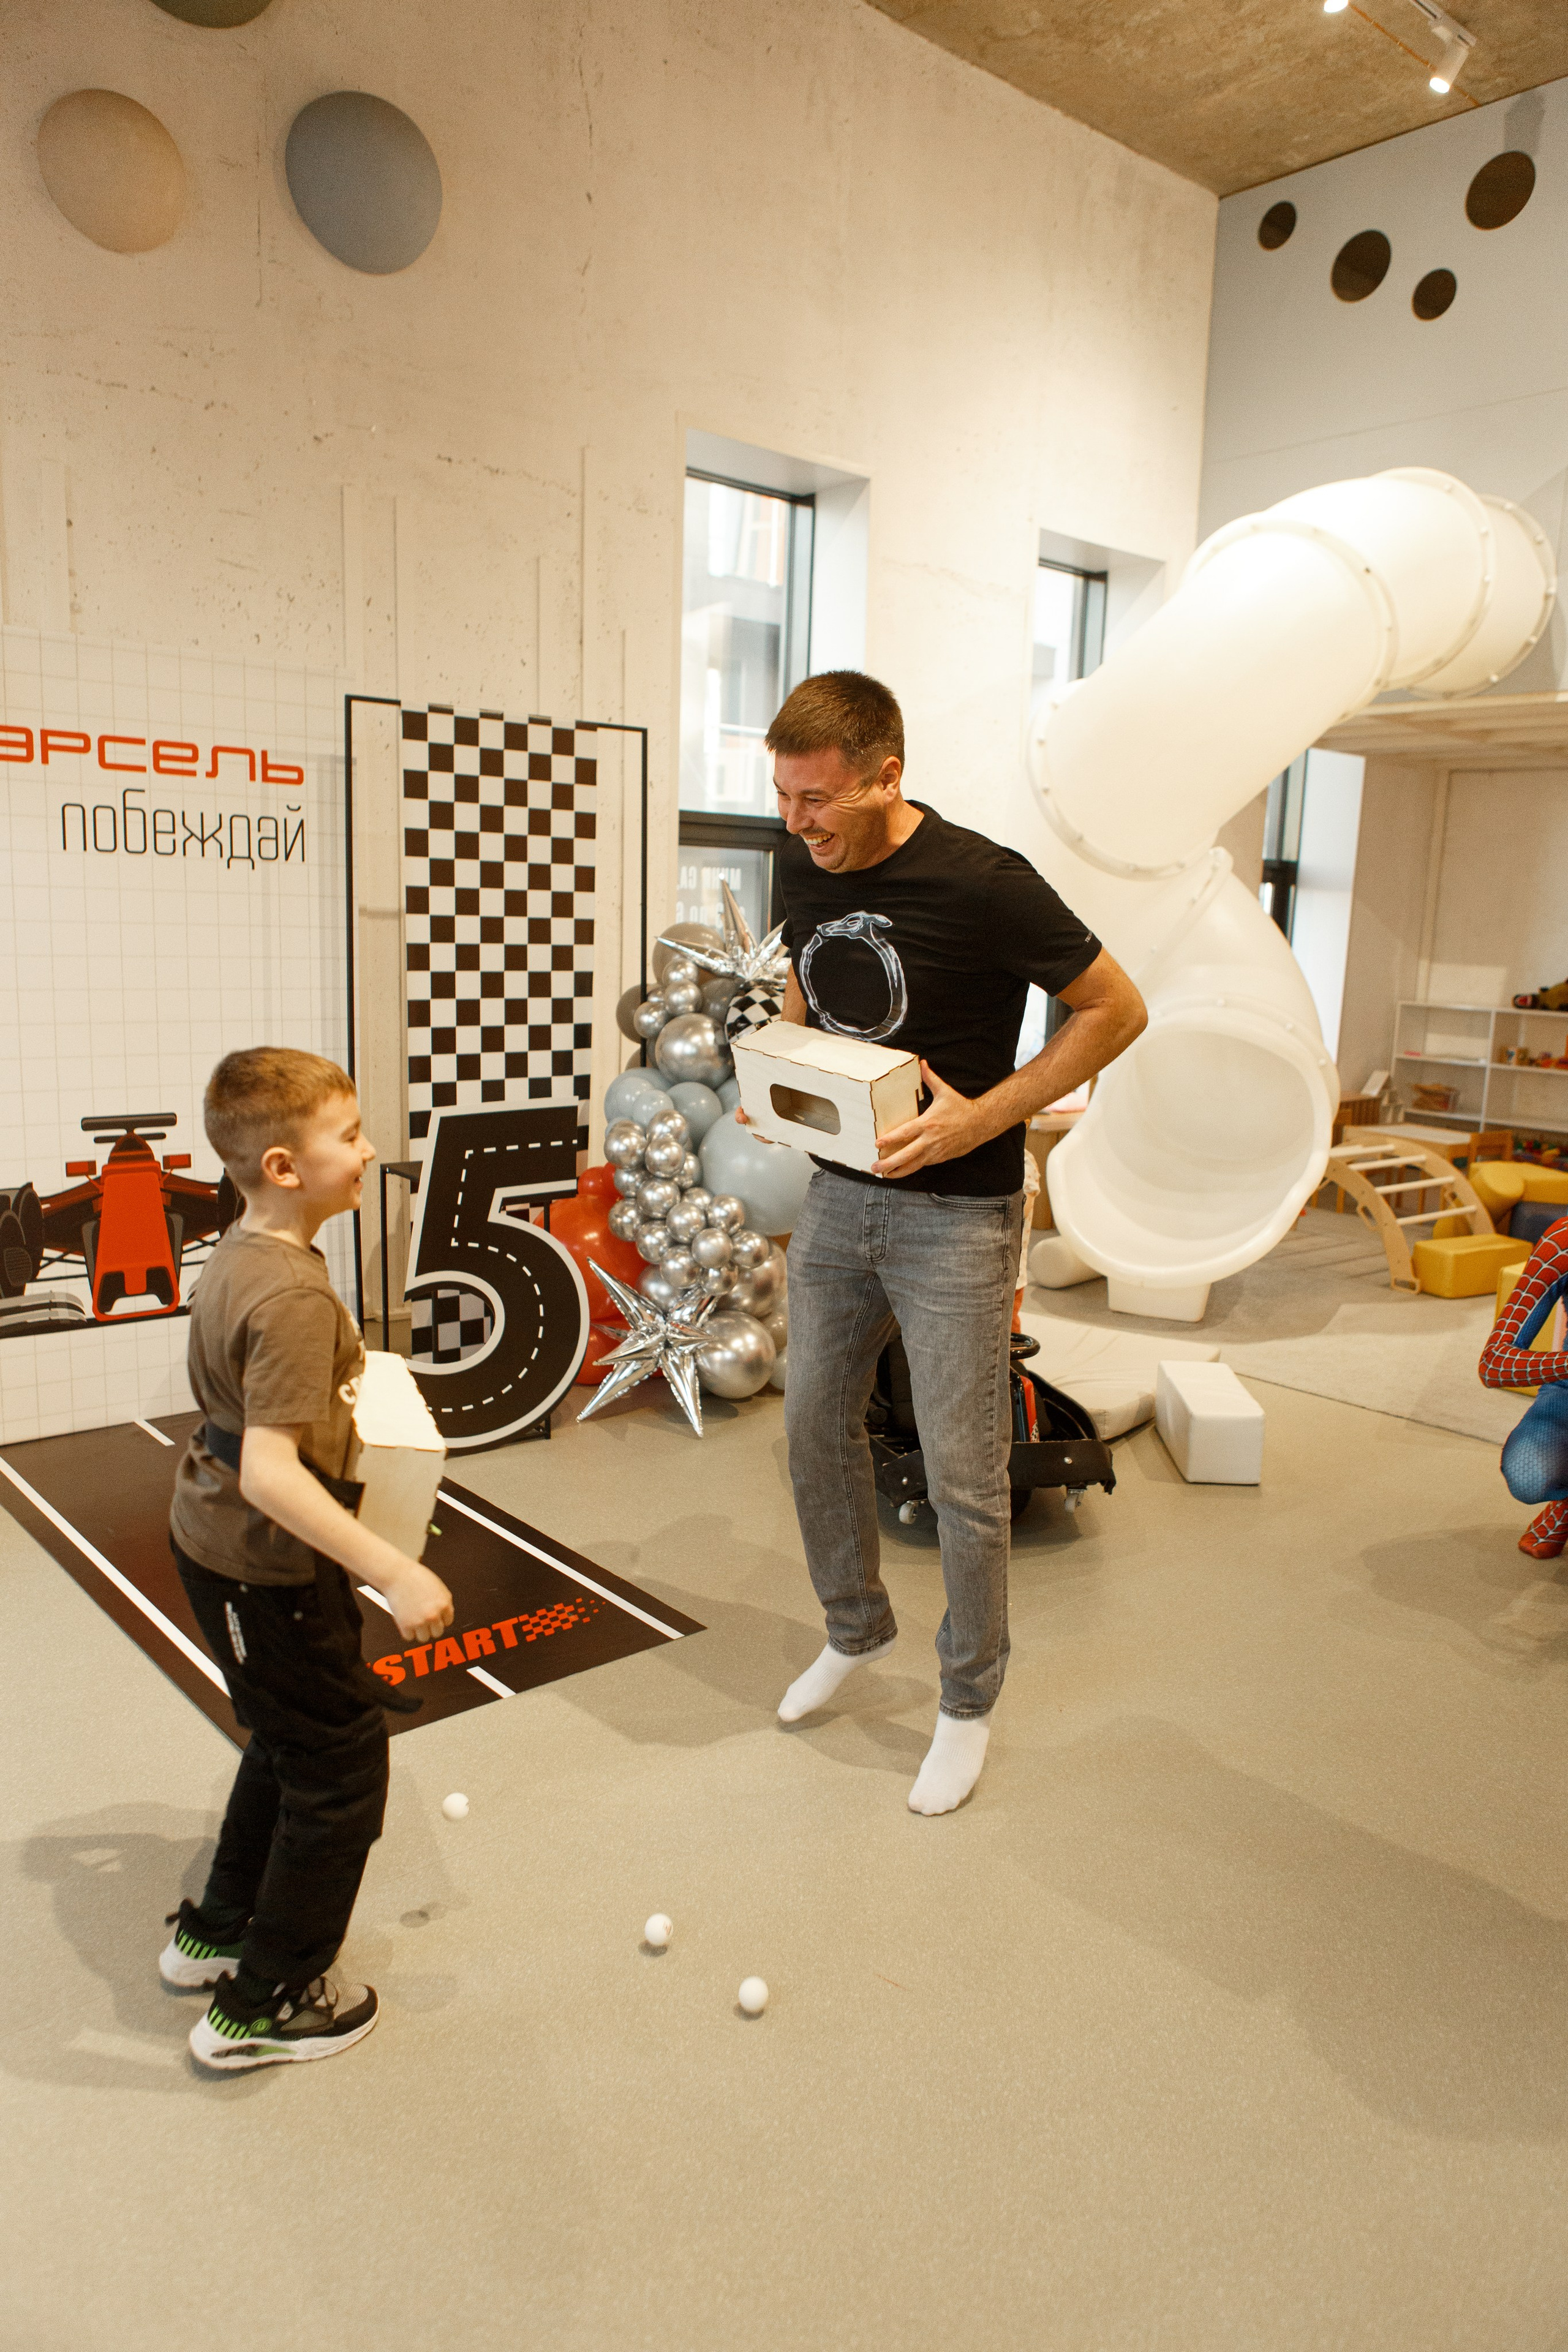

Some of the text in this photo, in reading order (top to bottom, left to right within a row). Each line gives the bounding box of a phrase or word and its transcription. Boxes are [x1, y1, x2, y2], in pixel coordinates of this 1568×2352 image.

[61, 788, 305, 870] побеждай
[404, 1095, 590, 1457] 5
[372, 1617, 518, 1686] START
